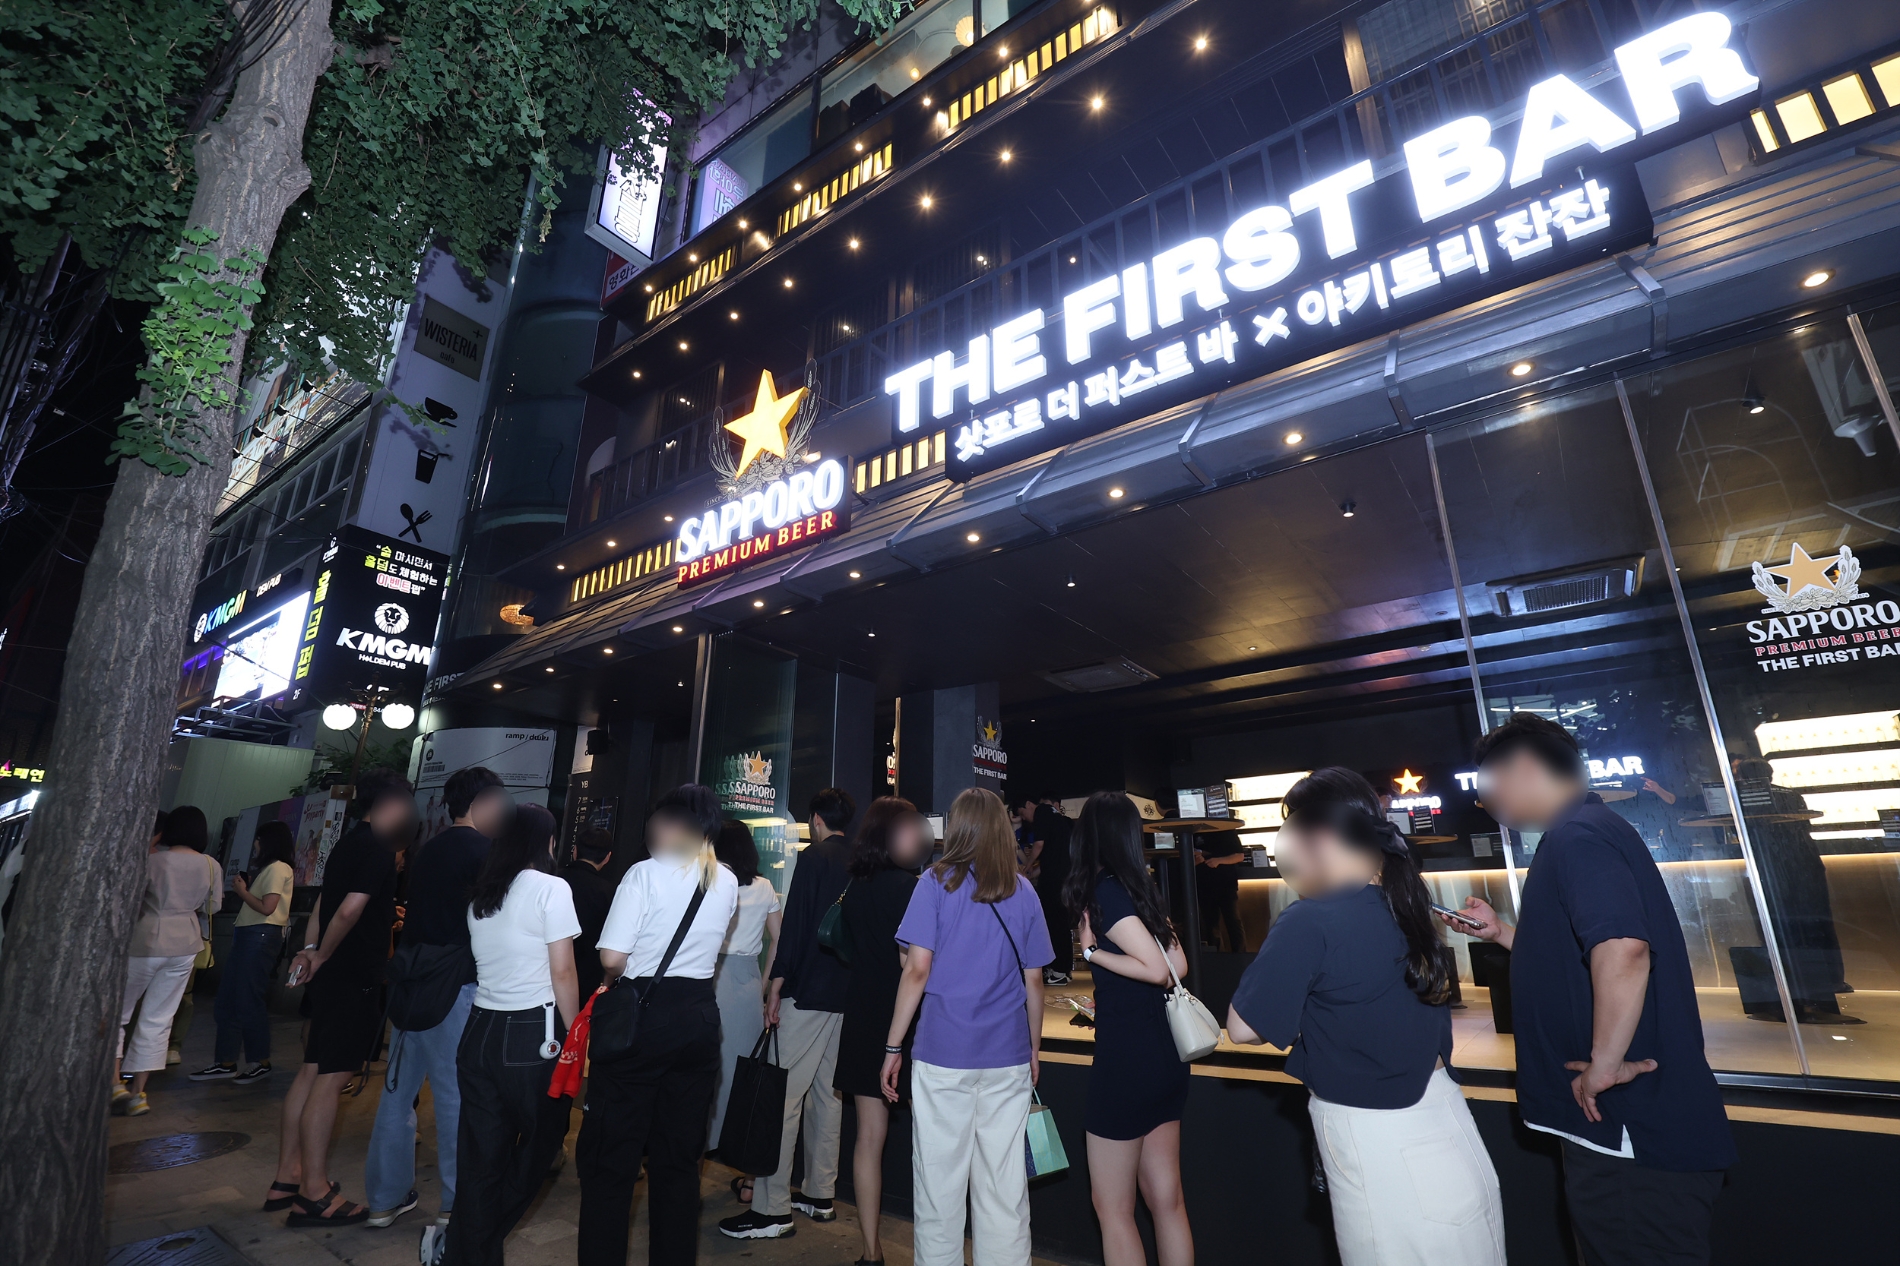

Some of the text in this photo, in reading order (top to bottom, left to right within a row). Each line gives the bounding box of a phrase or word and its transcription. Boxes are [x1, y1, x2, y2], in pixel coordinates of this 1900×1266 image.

[885, 11, 1760, 433] THE FIRST BAR
[424, 318, 478, 361] WISTERIA
[954, 397, 1046, 463] 삿포로
[1047, 381, 1080, 421] 더
[1084, 341, 1194, 406] 퍼스트
[1197, 320, 1239, 364] 바
[1297, 225, 1490, 327] 야키토리
[1494, 179, 1611, 262] 잔잔
[677, 459, 845, 563] SAPPORO
[678, 510, 835, 583] PREMIUM BEER
[204, 590, 248, 634] KMGM
[1746, 600, 1900, 643] SAPPORO
[336, 627, 432, 666] KMGM
[390, 660, 407, 670] PUB
[1755, 635, 1848, 657] PREMIUM
[1757, 656, 1801, 673] THE
[1802, 648, 1861, 667] FIRST
[973, 745, 1008, 765] SAPPORO
[1588, 755, 1646, 778] BAR
[735, 781, 776, 800] SAPPORO
[762, 806, 774, 814] BAR
